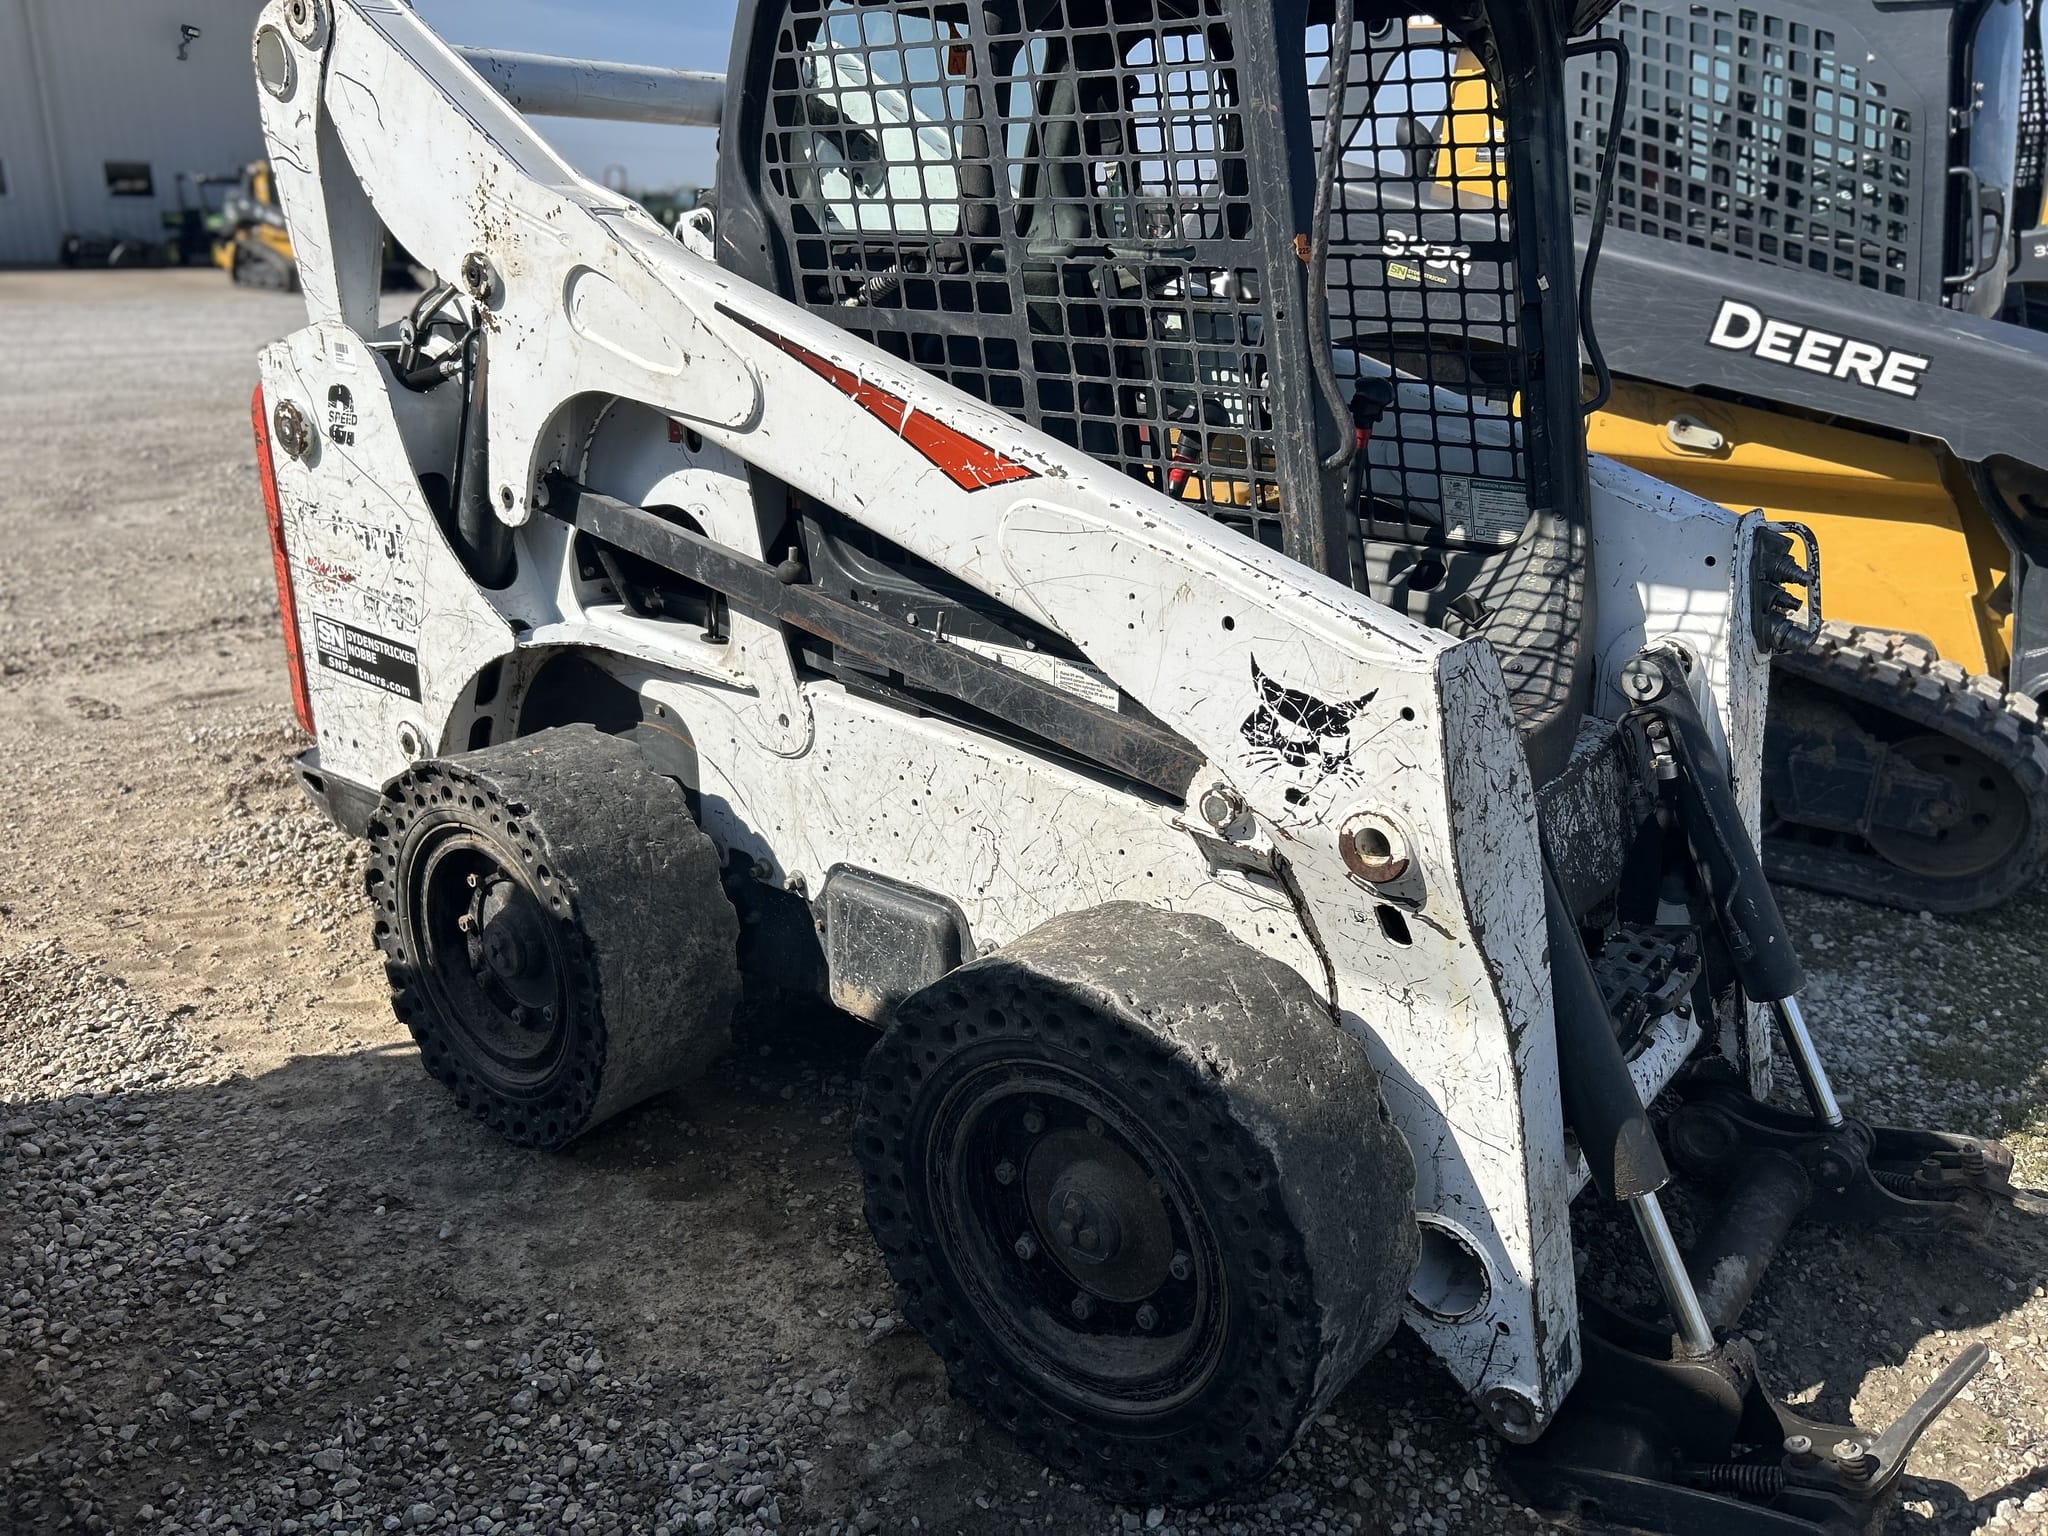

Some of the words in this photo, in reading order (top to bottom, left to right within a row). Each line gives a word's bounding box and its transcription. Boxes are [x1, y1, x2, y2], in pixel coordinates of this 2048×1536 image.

[1709, 299, 1929, 397] DEERE
[328, 411, 358, 426] SPEED
[317, 620, 344, 649] SN
[319, 640, 346, 656] PARTNERS
[346, 630, 417, 666] SYDENSTRICKER
[348, 643, 378, 665] NOBBE
[328, 655, 411, 697] SNPartners.com
